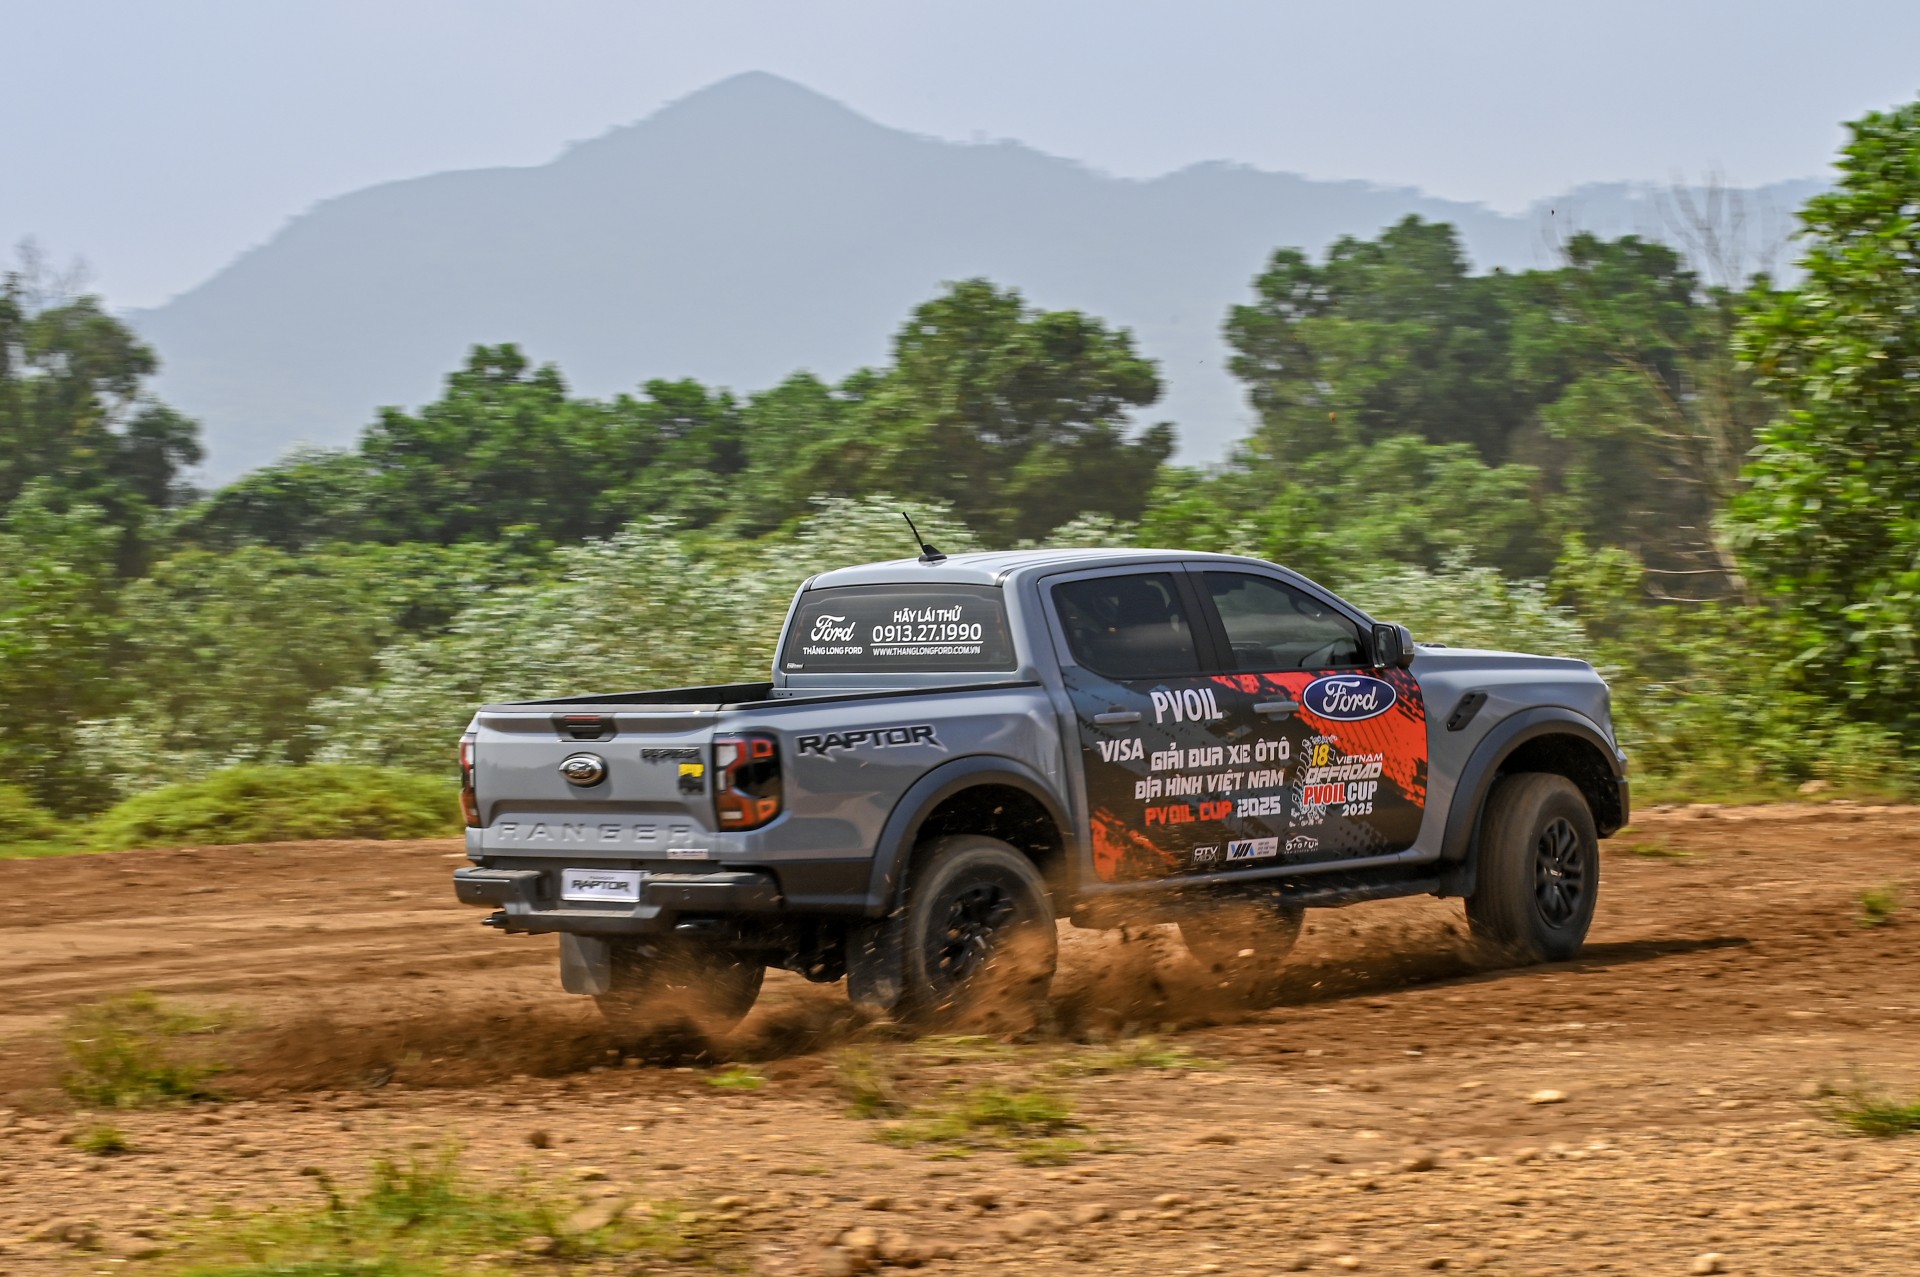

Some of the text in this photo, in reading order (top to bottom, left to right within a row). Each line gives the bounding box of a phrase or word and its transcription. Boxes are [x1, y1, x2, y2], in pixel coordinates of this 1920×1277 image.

[894, 605, 962, 622] HÃY LÁI THỬ
[811, 614, 856, 642] Ford
[872, 623, 982, 642] 0913.27.1990
[826, 646, 844, 655] LONG
[845, 646, 863, 655] FORD
[1150, 688, 1223, 724] PVOIL
[1322, 680, 1378, 713] Ford
[796, 724, 949, 762] RAPTOR
[1096, 738, 1144, 763] VISA
[1226, 743, 1250, 765] XE
[1255, 736, 1290, 762] ÔTÔ
[1312, 743, 1330, 767] 18
[1336, 753, 1383, 765] VIETNAM
[1165, 773, 1203, 796] HÌNH
[1206, 769, 1244, 795] VIỆT
[1247, 769, 1285, 789] NAM
[1305, 762, 1383, 784] OFFROAD
[1303, 781, 1378, 806] PVOIL CUP
[1145, 795, 1281, 827] PVOIL CUP 2025
[1341, 802, 1373, 817] 2025
[572, 879, 632, 893] RAPTOR
